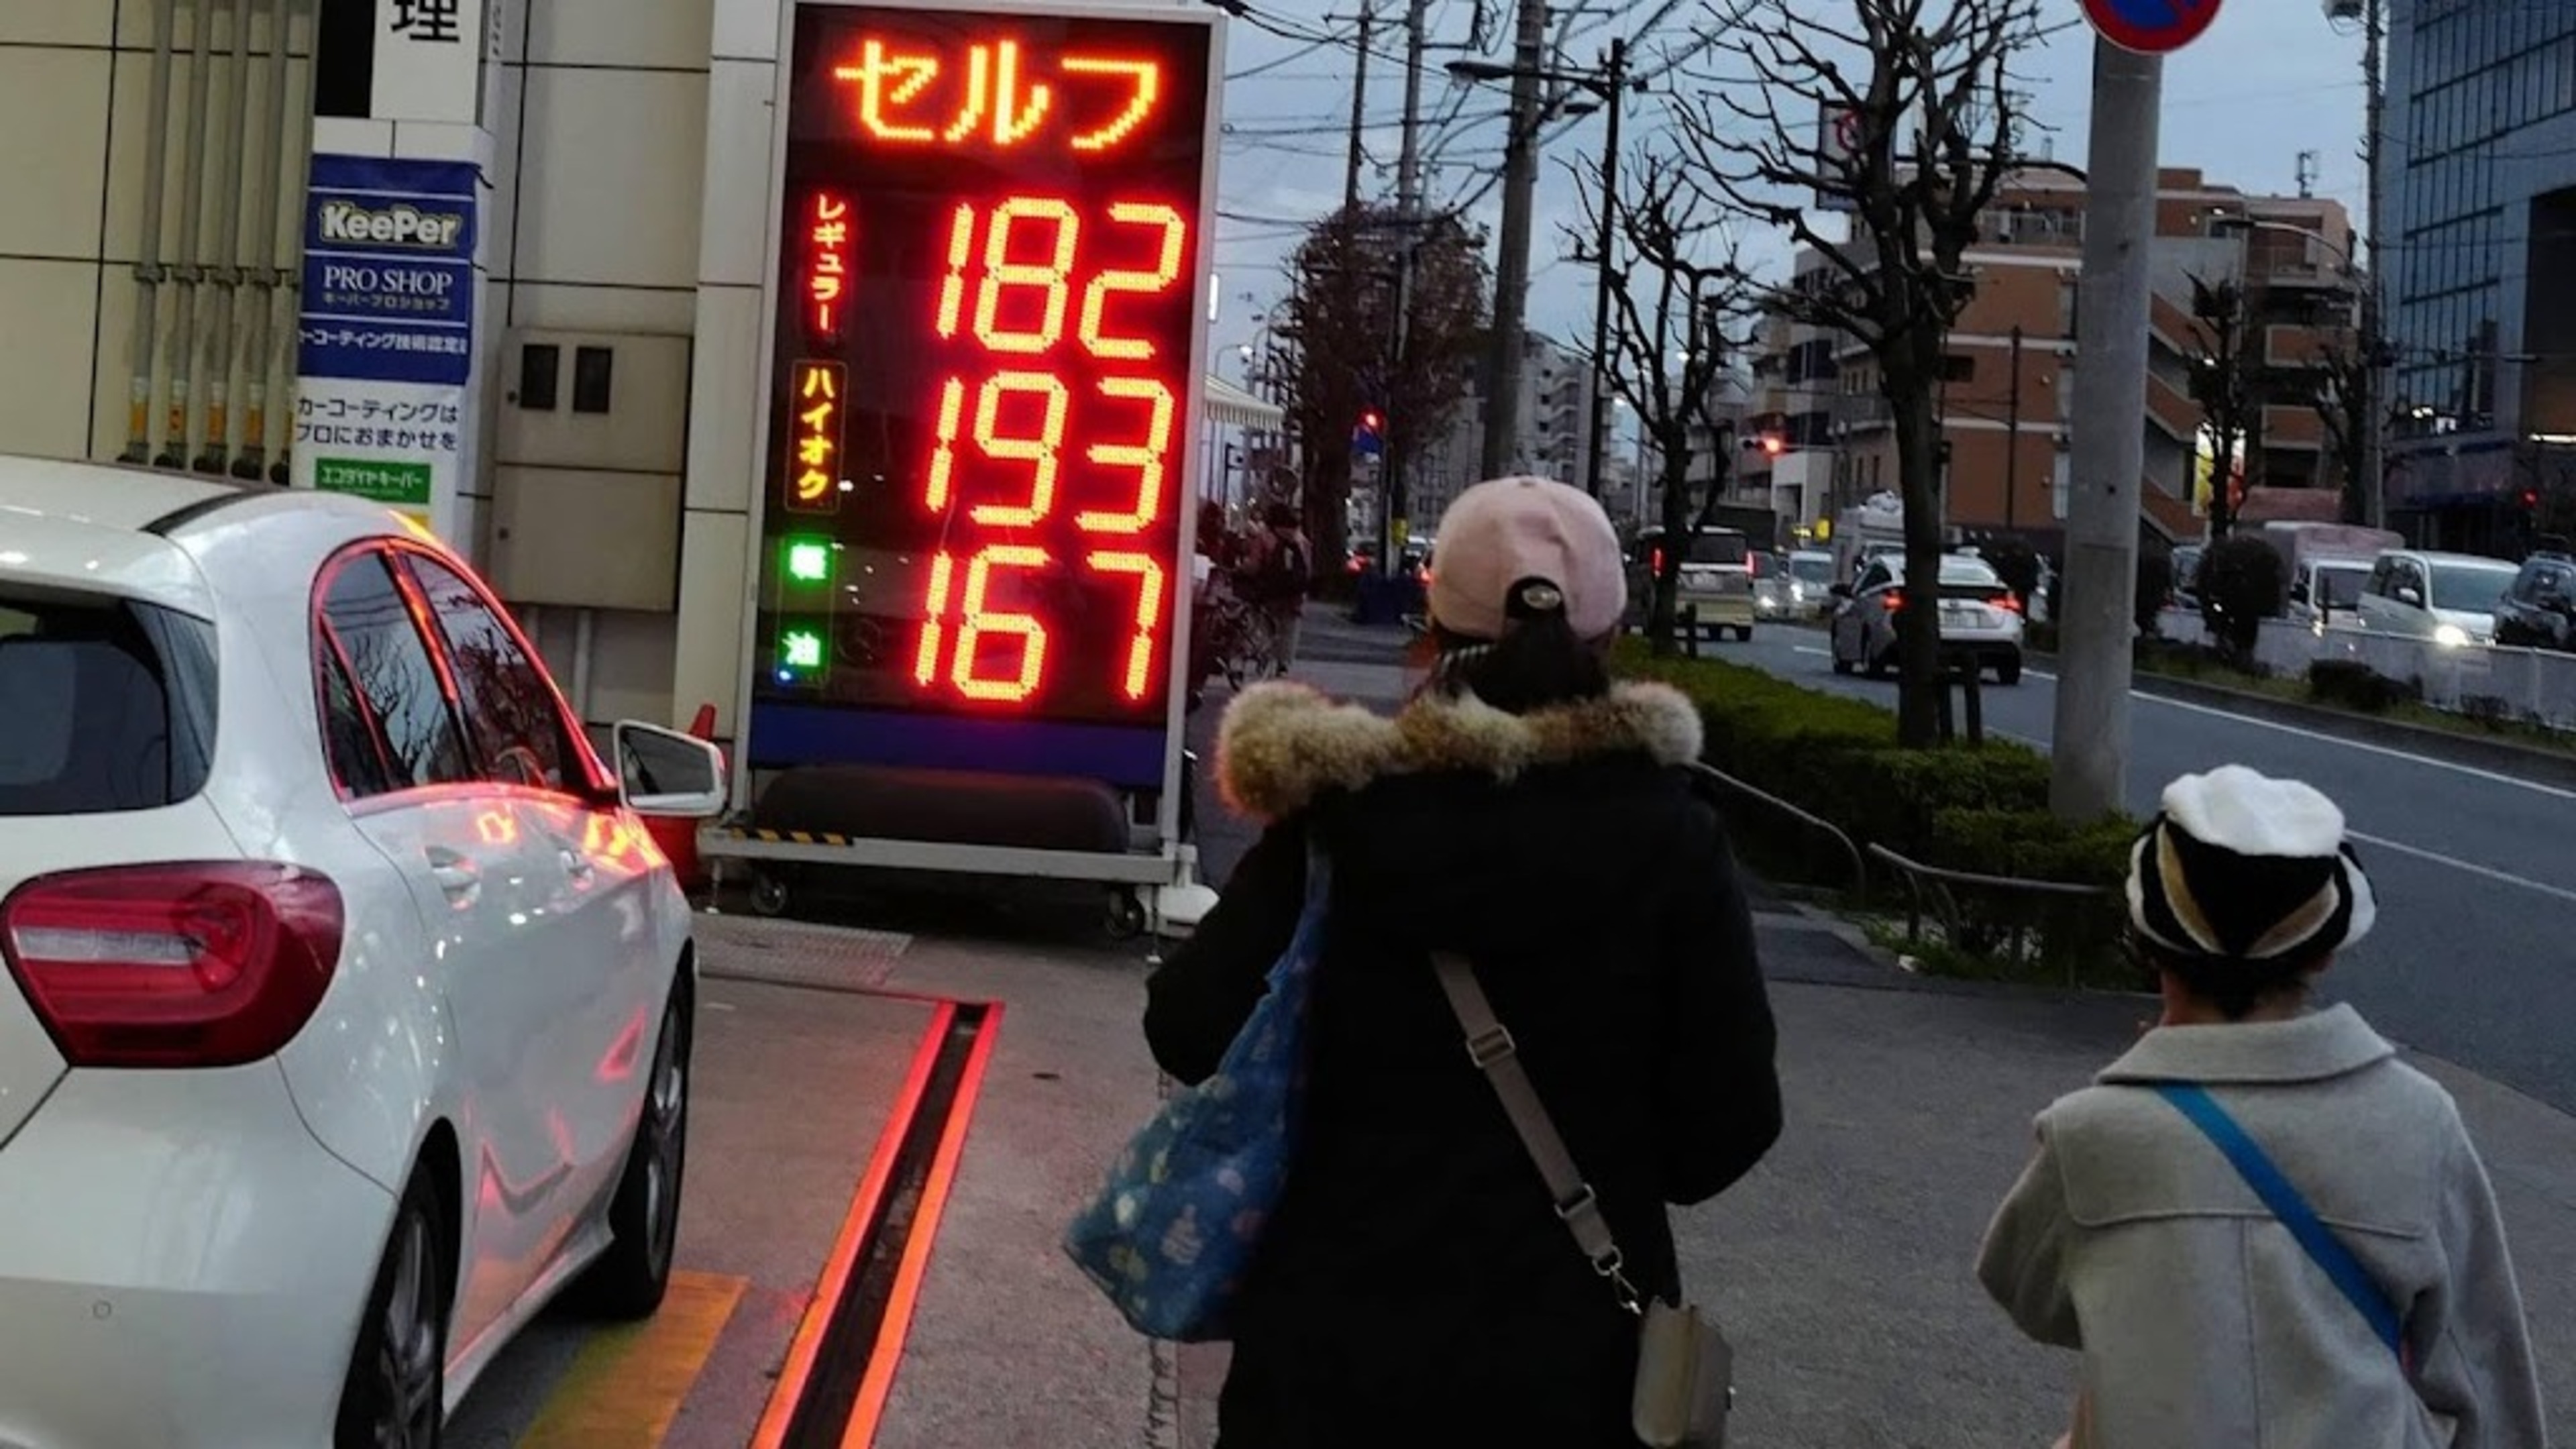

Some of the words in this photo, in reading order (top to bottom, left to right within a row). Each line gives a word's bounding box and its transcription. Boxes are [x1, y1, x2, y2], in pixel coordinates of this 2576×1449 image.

[391, 0, 460, 43] 理
[835, 40, 1159, 149] セルフ
[322, 203, 458, 246] KeePer
[811, 194, 846, 330] レギュラー
[937, 196, 1185, 358] 182
[323, 266, 378, 292] PRO
[382, 268, 453, 295] SHOP
[296, 423, 457, 451] プロにおまかせを
[298, 396, 458, 424] カーコーティングは
[798, 368, 835, 500] ハイオク
[924, 371, 1173, 533] 193
[915, 543, 1163, 701] 167
